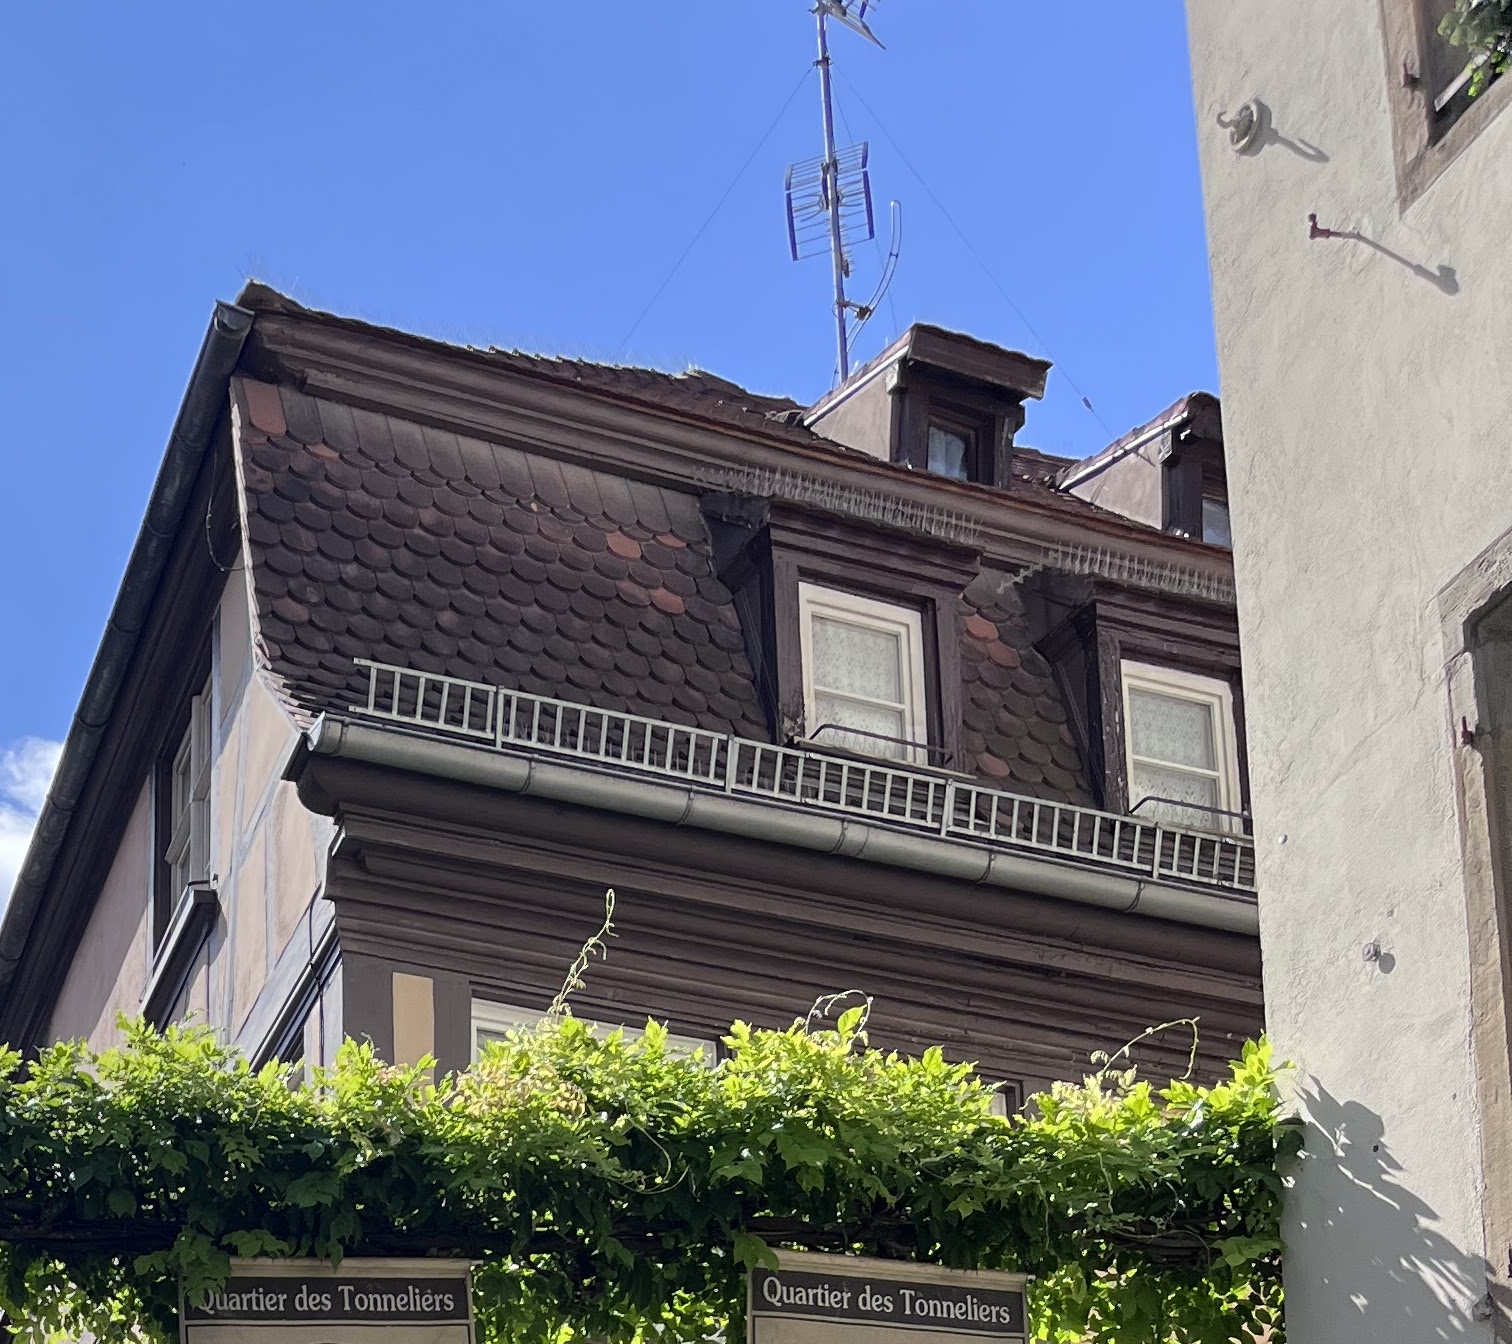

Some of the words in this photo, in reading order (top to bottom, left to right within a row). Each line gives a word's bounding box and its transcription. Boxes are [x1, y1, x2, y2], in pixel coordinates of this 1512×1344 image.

[294, 1284, 332, 1312] des
[337, 1284, 455, 1312] Tonneliers
[762, 1276, 852, 1309] Quartier
[857, 1286, 894, 1314] des
[899, 1289, 1011, 1325] Tonneliers
